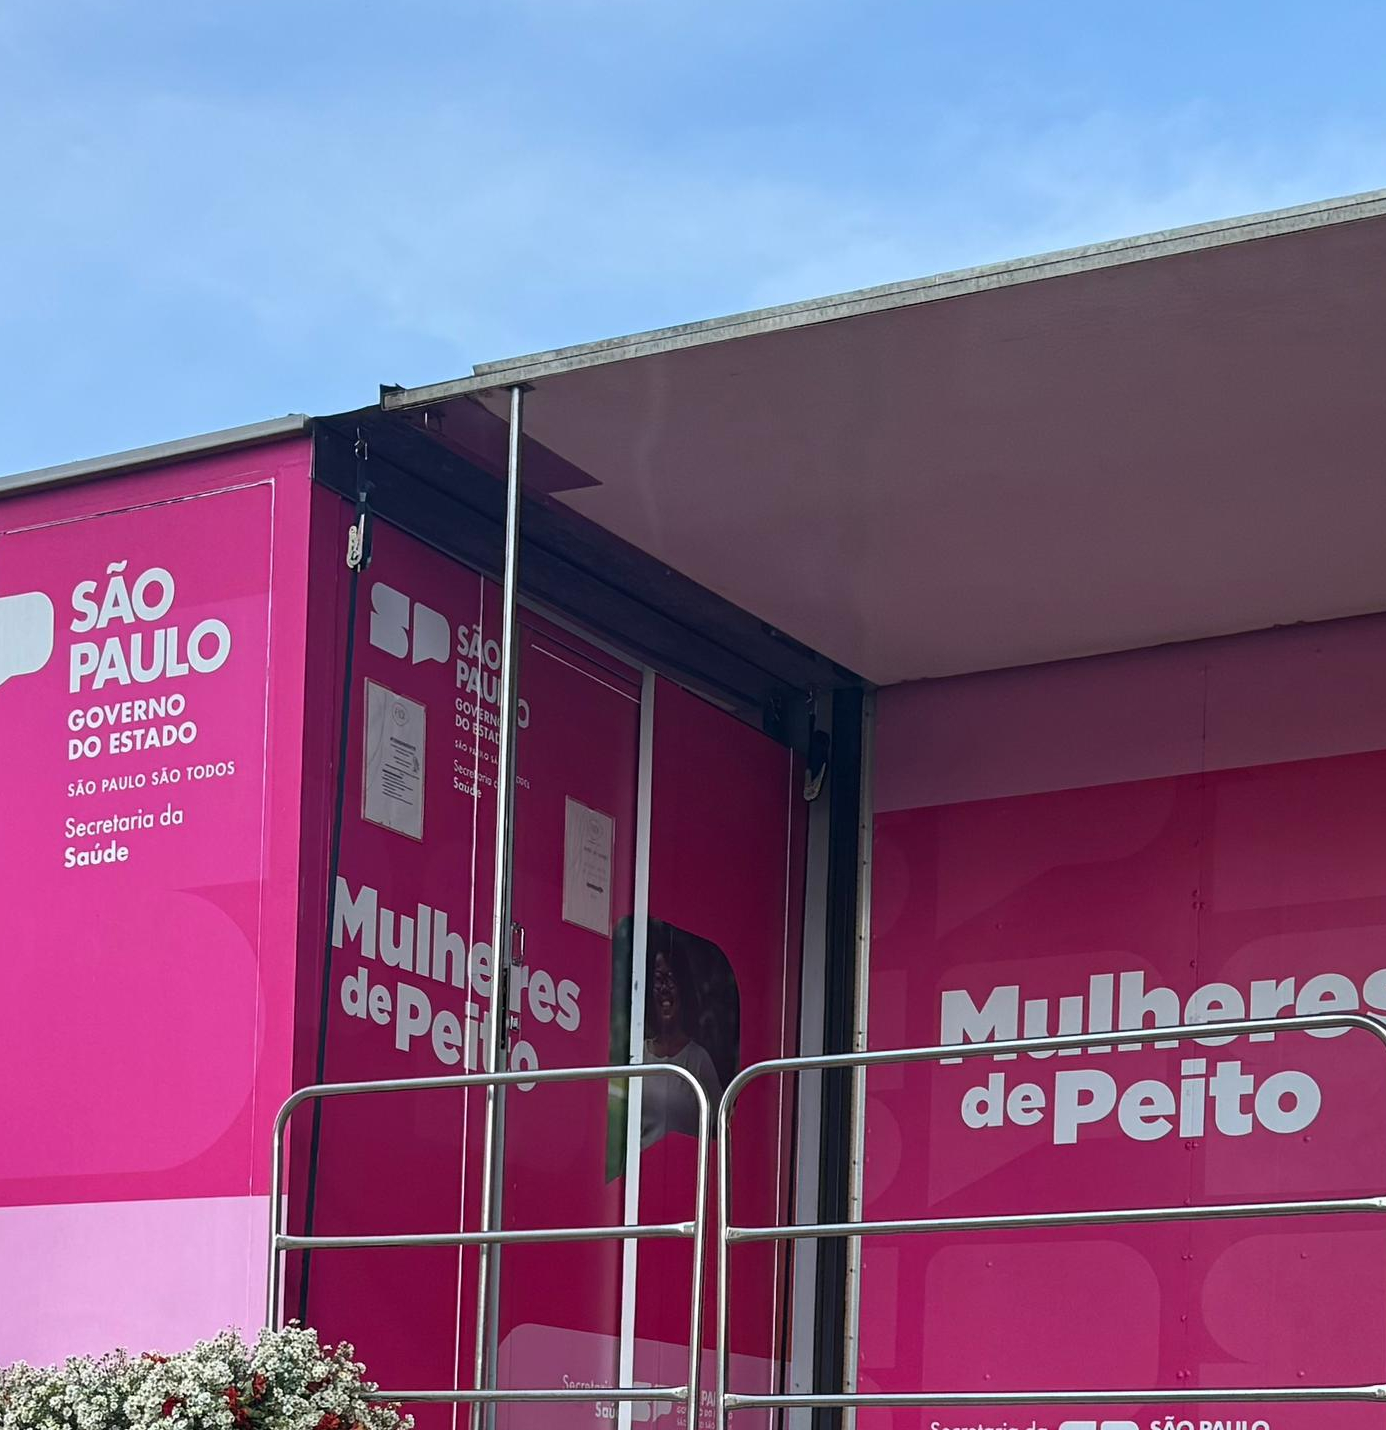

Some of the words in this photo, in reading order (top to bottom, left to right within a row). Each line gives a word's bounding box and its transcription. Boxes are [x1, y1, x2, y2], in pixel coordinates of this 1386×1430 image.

[70, 560, 175, 633] SÃO
[69, 618, 231, 694] PAULO
[457, 624, 501, 670] SÃO
[68, 694, 185, 731] GOVERNO
[68, 736, 102, 760] DO
[109, 722, 197, 754] ESTADO
[67, 780, 96, 797] SÃO
[102, 774, 145, 792] PAULO
[151, 768, 180, 786] SÃO
[187, 761, 235, 780] TODOS
[65, 809, 154, 838] Secretaria
[159, 803, 184, 826] da
[64, 841, 128, 868] Saúde
[332, 875, 580, 1031] Mulheres
[341, 966, 392, 1025] de
[961, 1072, 1046, 1129] de
[1053, 1058, 1322, 1144] Peito
[595, 1402, 615, 1419] Saú
